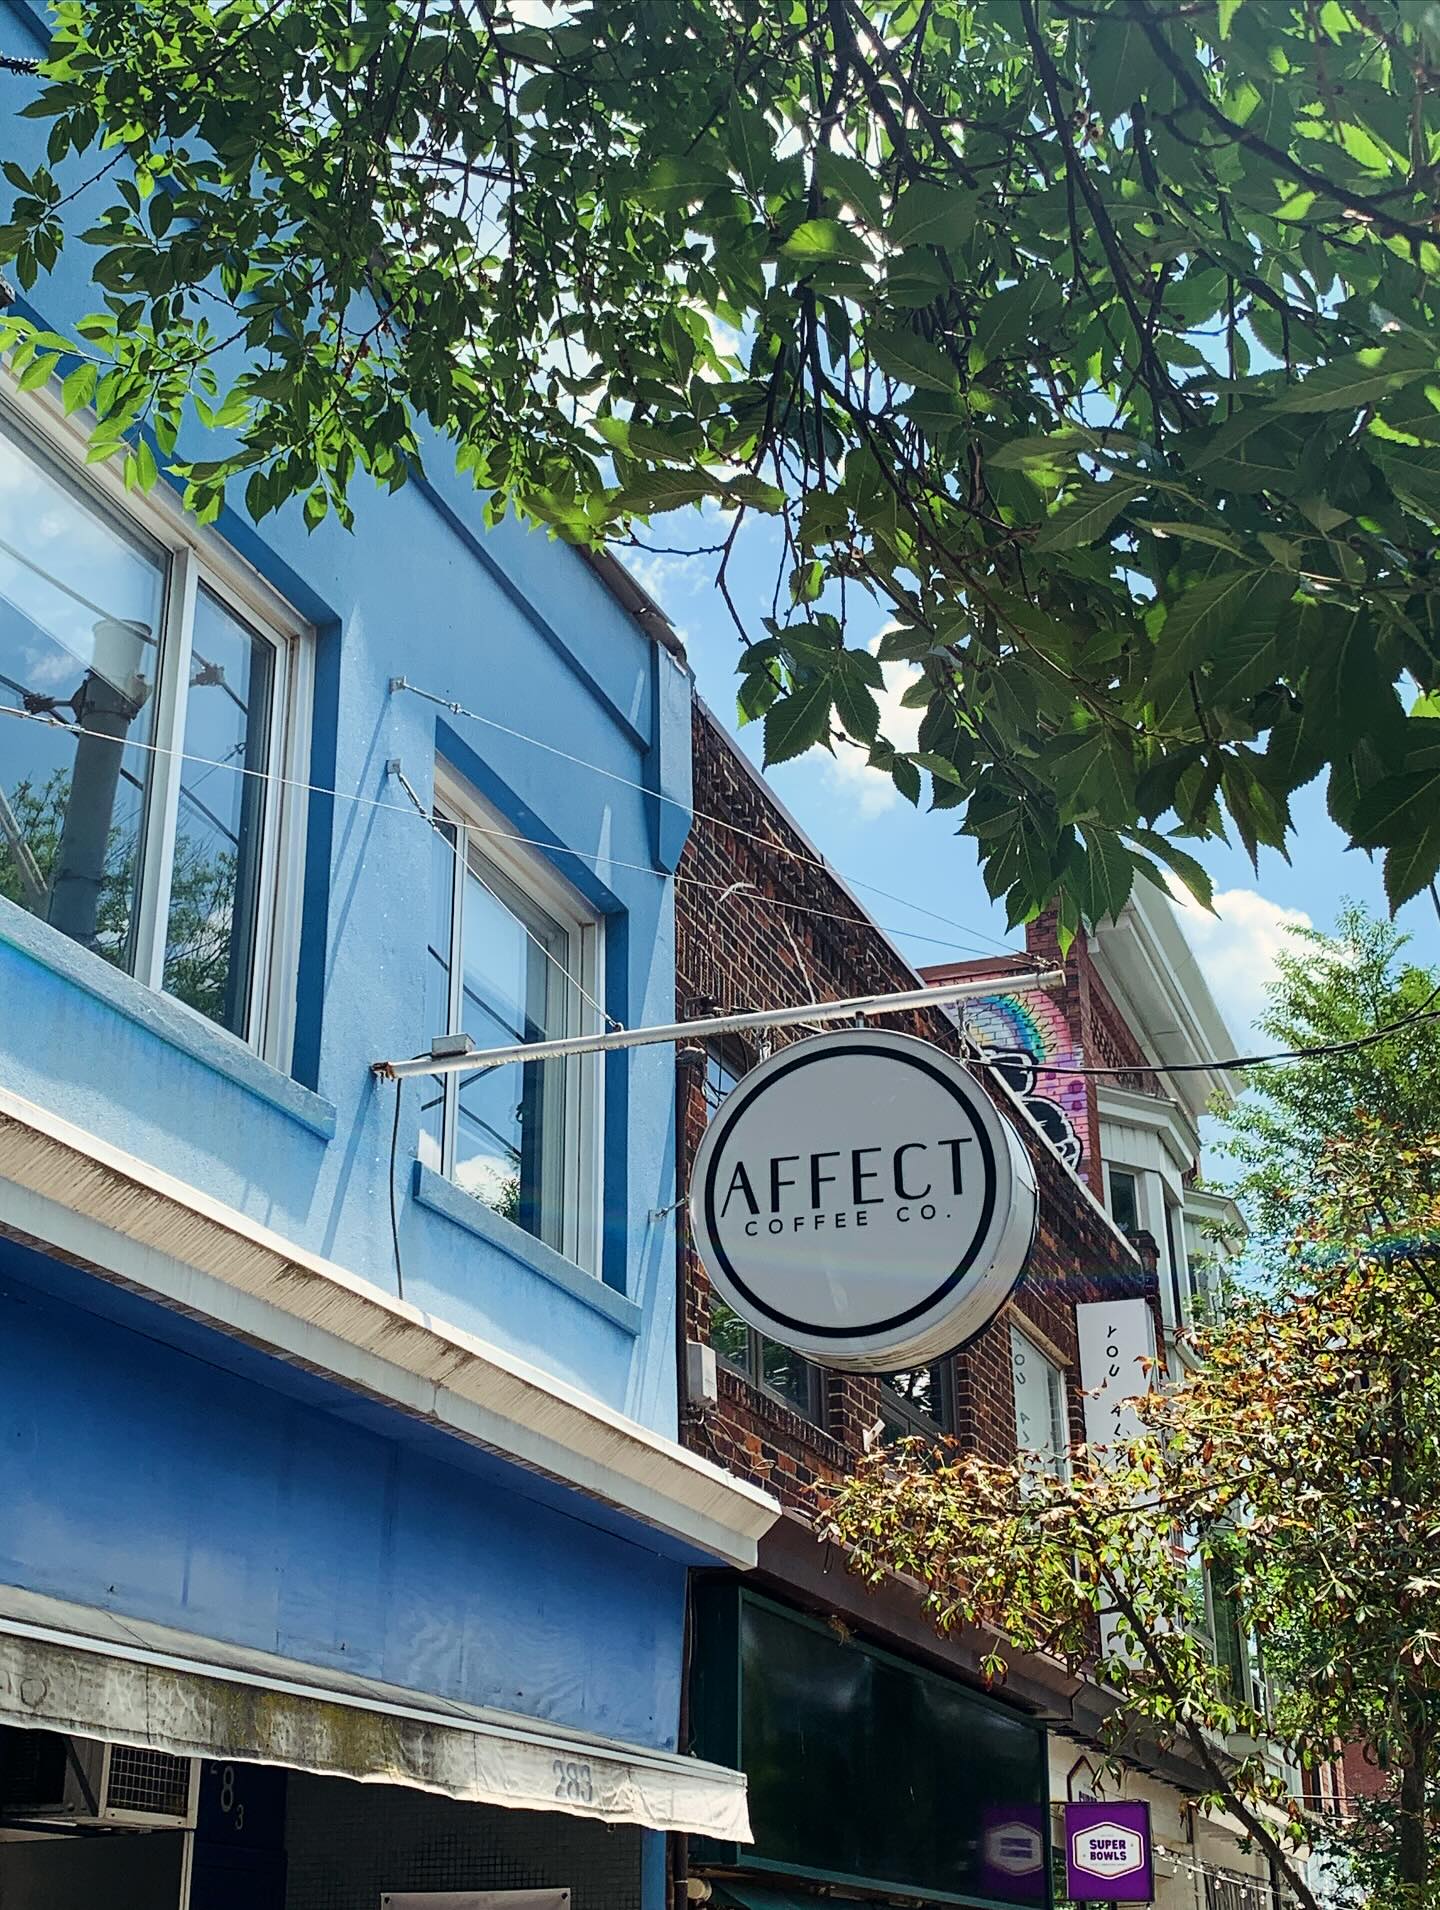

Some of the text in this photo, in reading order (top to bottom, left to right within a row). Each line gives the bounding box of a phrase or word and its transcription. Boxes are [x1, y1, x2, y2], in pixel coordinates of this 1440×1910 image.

[721, 1137, 973, 1218] AFFECT
[744, 1204, 951, 1237] COFFEE CO.
[1106, 1325, 1120, 1377] YOU
[552, 1759, 593, 1803] 283
[1089, 1838, 1127, 1850] SUPER
[1089, 1851, 1127, 1861] BOWLS
